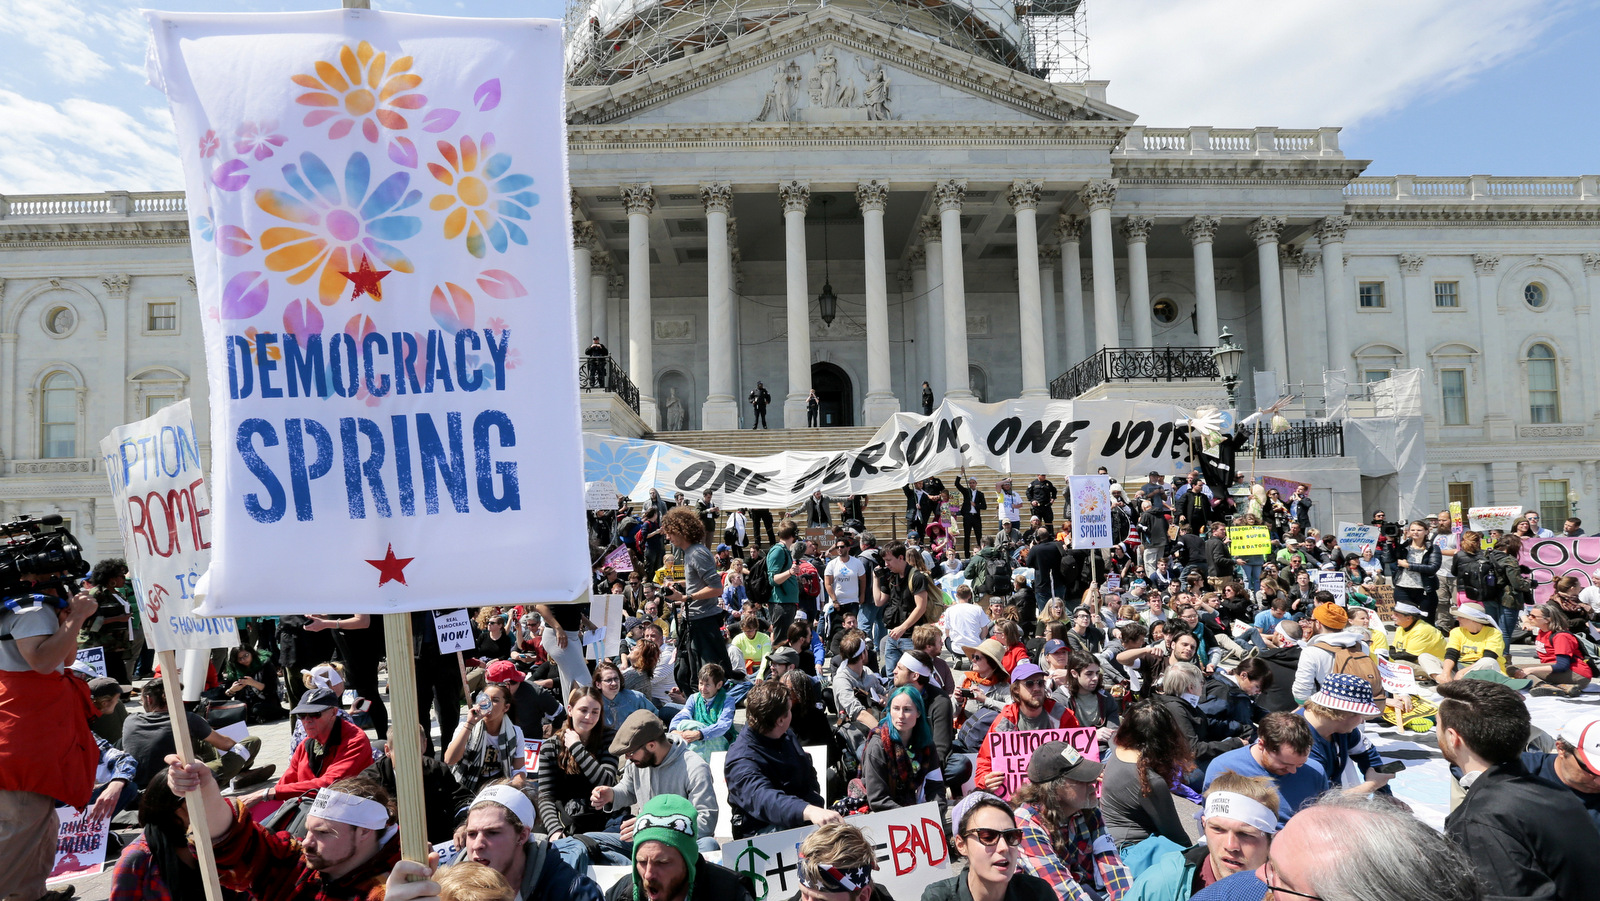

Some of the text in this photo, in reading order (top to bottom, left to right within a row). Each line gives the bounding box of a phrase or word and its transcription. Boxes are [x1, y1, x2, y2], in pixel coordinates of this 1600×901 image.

[226, 328, 511, 399] DEMOCRACY
[675, 460, 781, 496] ONE
[986, 416, 1090, 457] ONE
[236, 409, 521, 524] SPRING
[1080, 513, 1106, 523] DEMOCRACY
[1080, 524, 1107, 538] SPRING
[169, 615, 234, 635] SHOWING
[438, 621, 468, 629] DEMOCRACY
[440, 629, 469, 642] NOW!
[1211, 804, 1230, 814] SPRING
[888, 817, 949, 877] BAD
